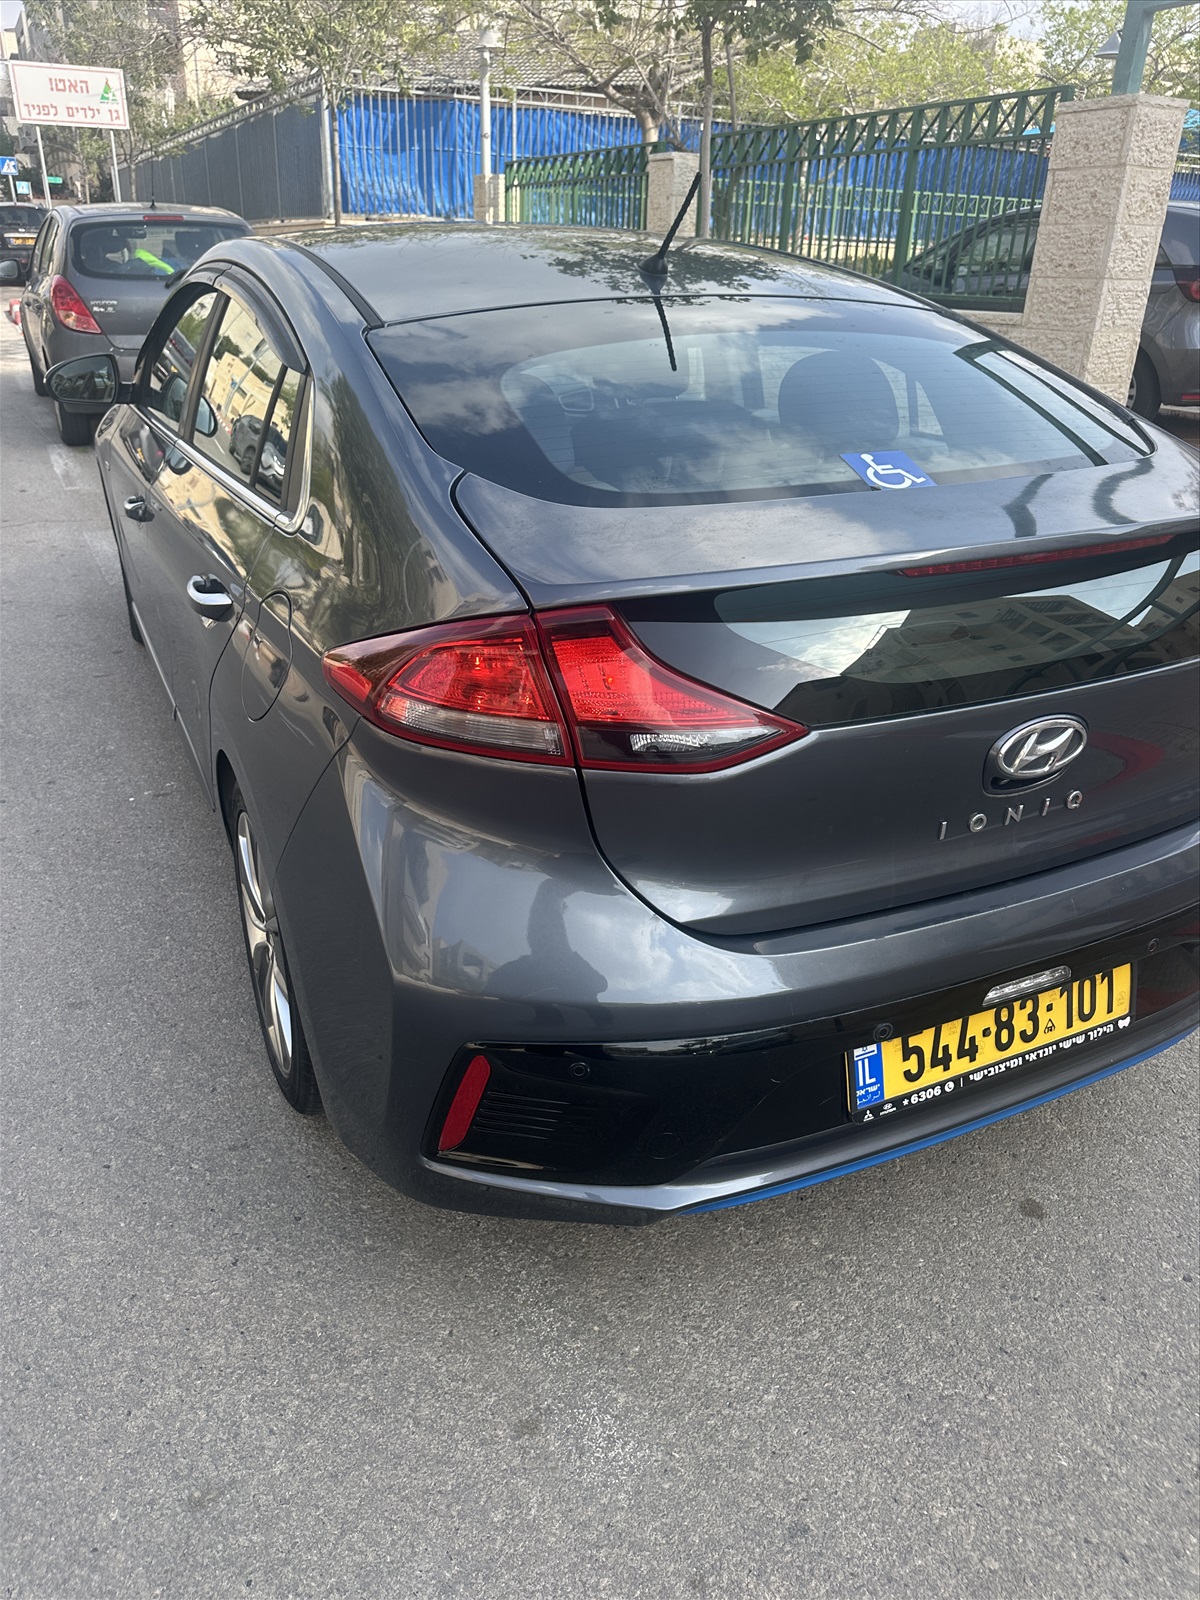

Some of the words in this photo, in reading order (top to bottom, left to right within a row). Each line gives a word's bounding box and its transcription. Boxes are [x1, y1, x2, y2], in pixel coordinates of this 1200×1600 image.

[49, 77, 90, 94] האט!
[24, 103, 58, 117] לפניך
[66, 106, 100, 119] ילדים
[108, 109, 121, 122] גן
[938, 789, 1083, 841] IONIQ
[1059, 1033, 1085, 1049] שישי
[1088, 1024, 1114, 1041] הילוך
[1025, 1044, 1057, 1062] יונדאי
[858, 1058, 876, 1087] IL
[969, 1056, 1022, 1081] ומיצובישי
